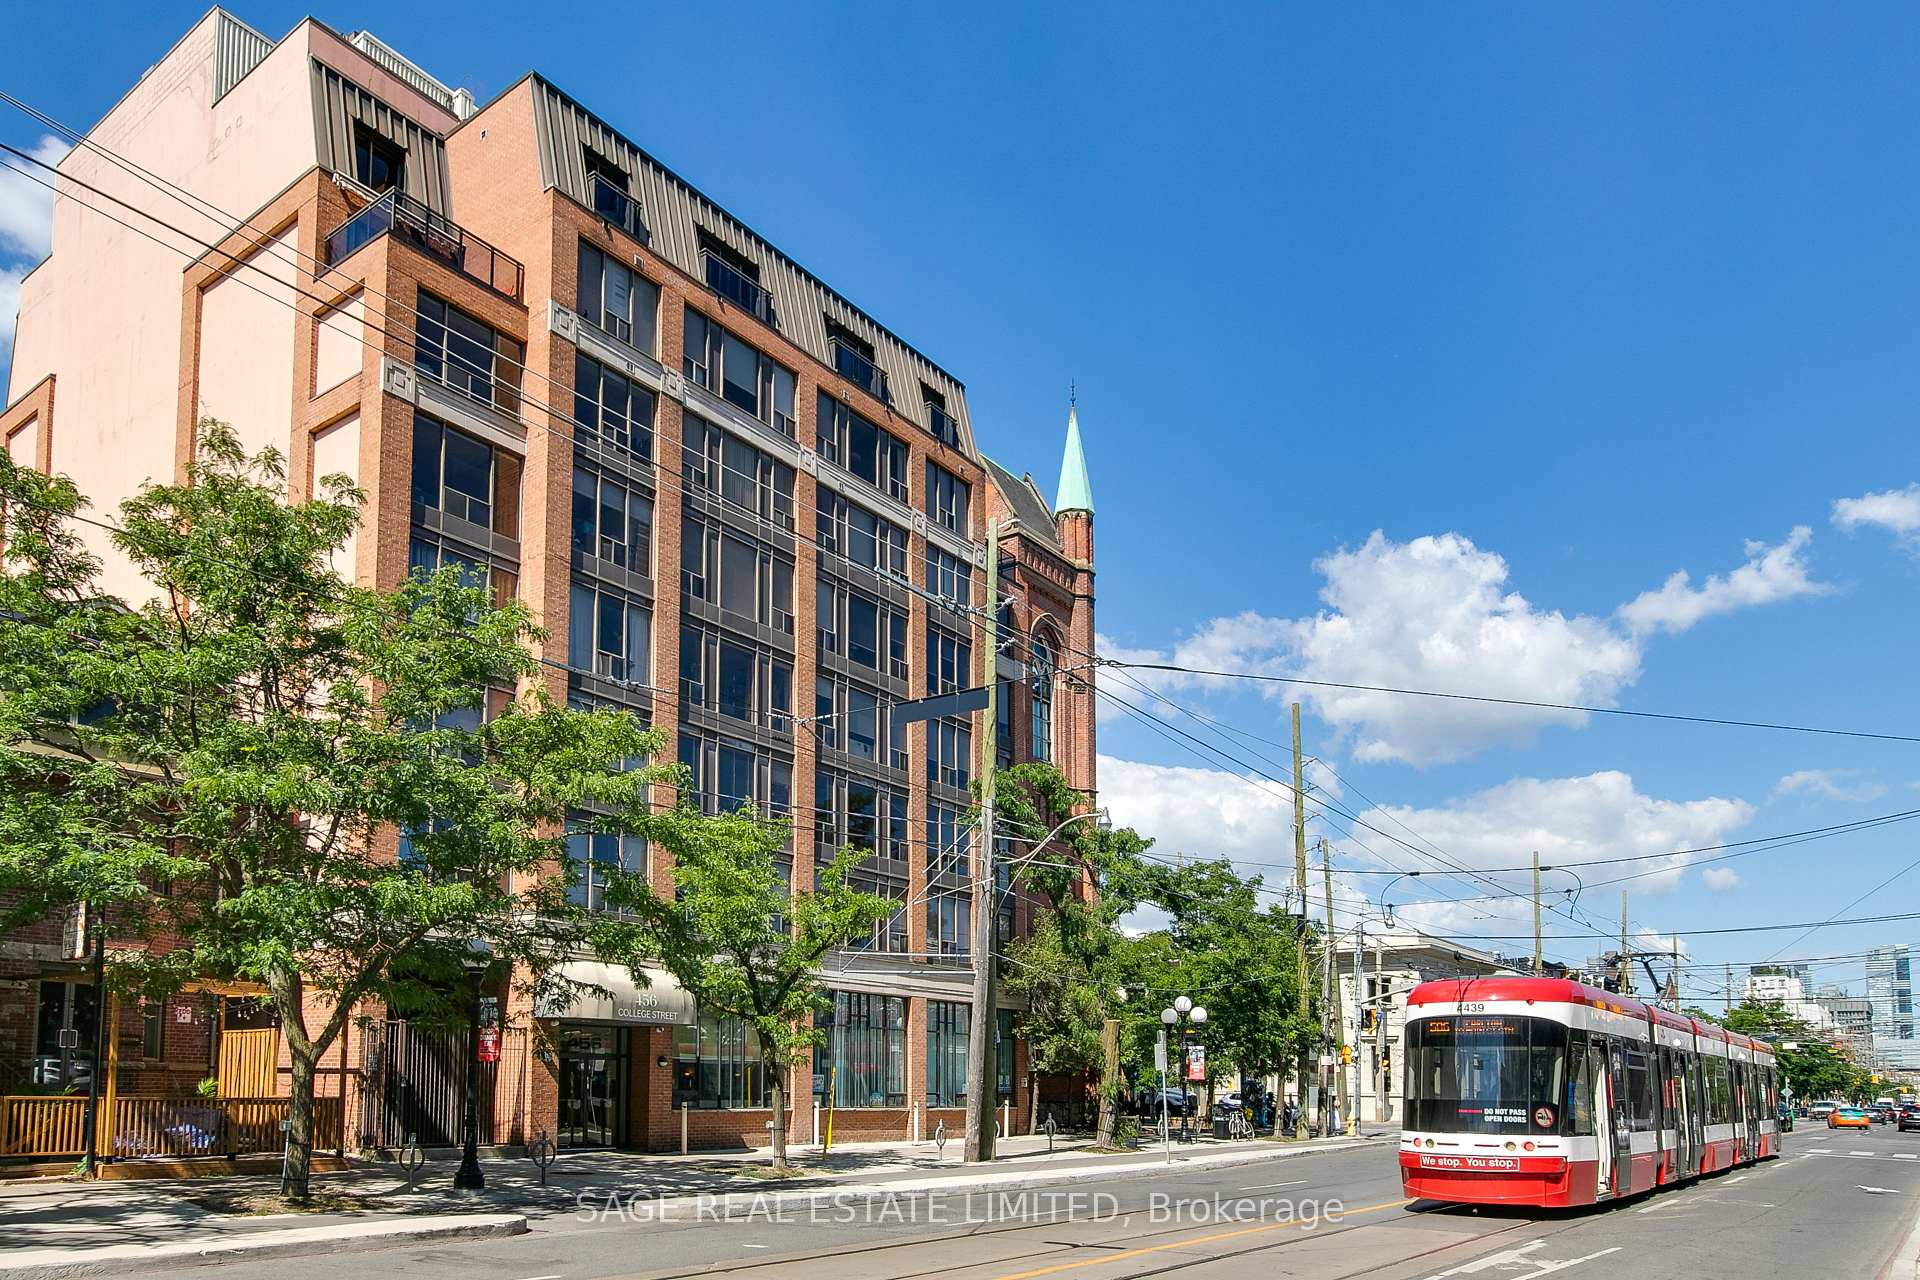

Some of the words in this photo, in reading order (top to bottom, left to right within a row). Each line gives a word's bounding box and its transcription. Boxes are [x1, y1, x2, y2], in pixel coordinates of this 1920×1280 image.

[635, 994, 658, 1007] 456
[617, 1007, 651, 1019] COLLEGE
[652, 1010, 678, 1020] STREET
[1457, 1003, 1485, 1013] 4439
[1429, 1021, 1450, 1032] 506
[1509, 1108, 1527, 1116] PASS
[1503, 1115, 1527, 1123] DOORS
[1421, 1156, 1436, 1166] We
[1438, 1157, 1463, 1168] stop.
[1466, 1157, 1486, 1167] You
[1488, 1157, 1517, 1169] stop.
